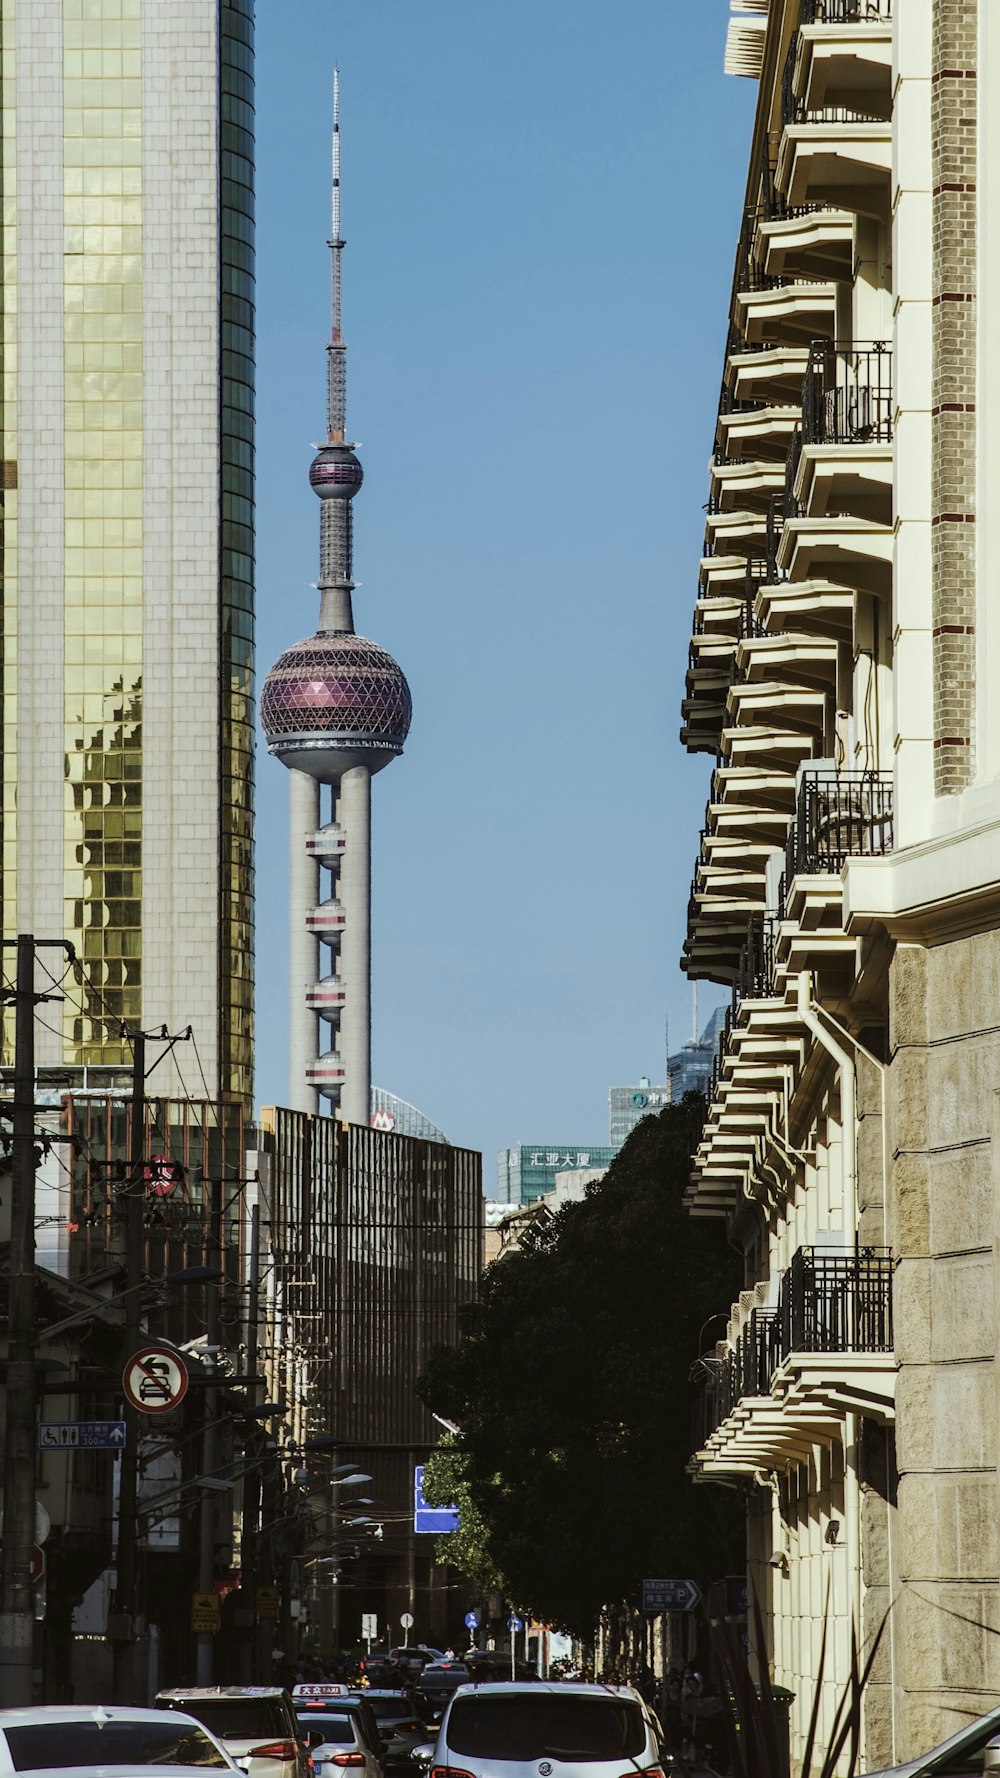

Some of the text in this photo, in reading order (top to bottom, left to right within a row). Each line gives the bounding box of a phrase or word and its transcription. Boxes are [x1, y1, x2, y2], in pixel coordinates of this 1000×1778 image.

[530, 1152, 591, 1167] 汇亚大厦
[302, 1686, 322, 1695] 大众
